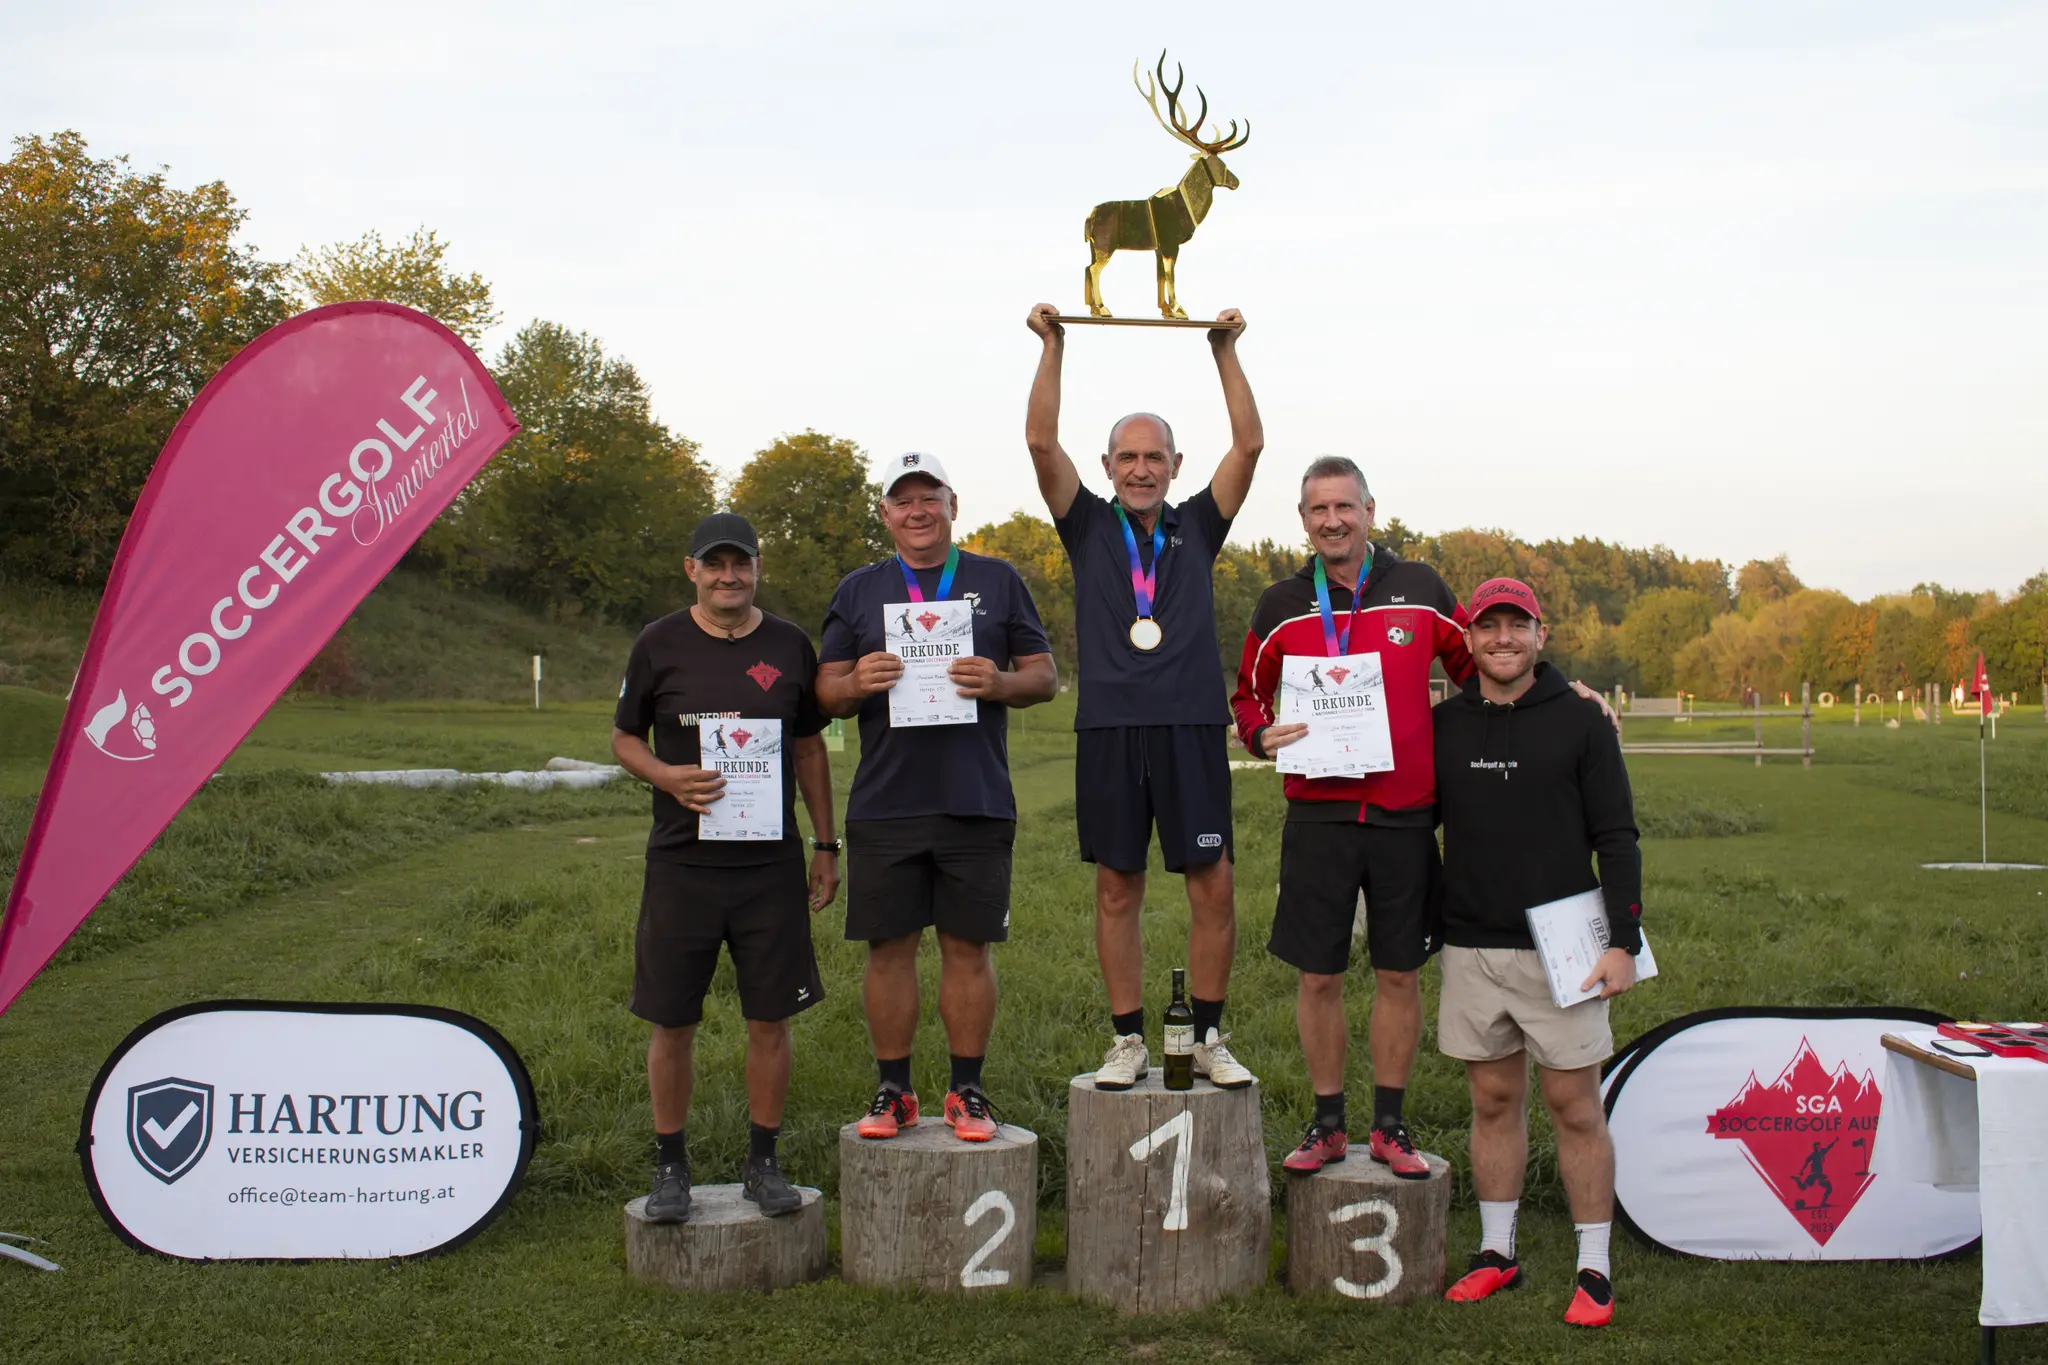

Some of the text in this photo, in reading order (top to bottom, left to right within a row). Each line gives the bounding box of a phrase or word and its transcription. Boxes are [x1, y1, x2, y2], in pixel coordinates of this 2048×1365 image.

[351, 377, 479, 546] Innviertel
[151, 375, 438, 708] SOCCERGOLF
[901, 643, 960, 658] URKUNDE
[1312, 694, 1372, 711] URKUNDE
[714, 761, 769, 773] URKUNDE
[1470, 761, 1498, 770] Socergolf
[1591, 917, 1610, 955] URKU
[227, 1090, 486, 1135] HARTUNG
[1795, 1095, 1843, 1114] SGA
[1718, 1116, 1842, 1133] SOCCERGOLF
[227, 1143, 484, 1164] VERSICHERUNGSMAKLER
[1128, 1110, 1193, 1230] 1
[228, 1185, 456, 1206] office@team-hartung.at
[960, 1190, 1016, 1288] 2
[1328, 1199, 1404, 1300] 3
